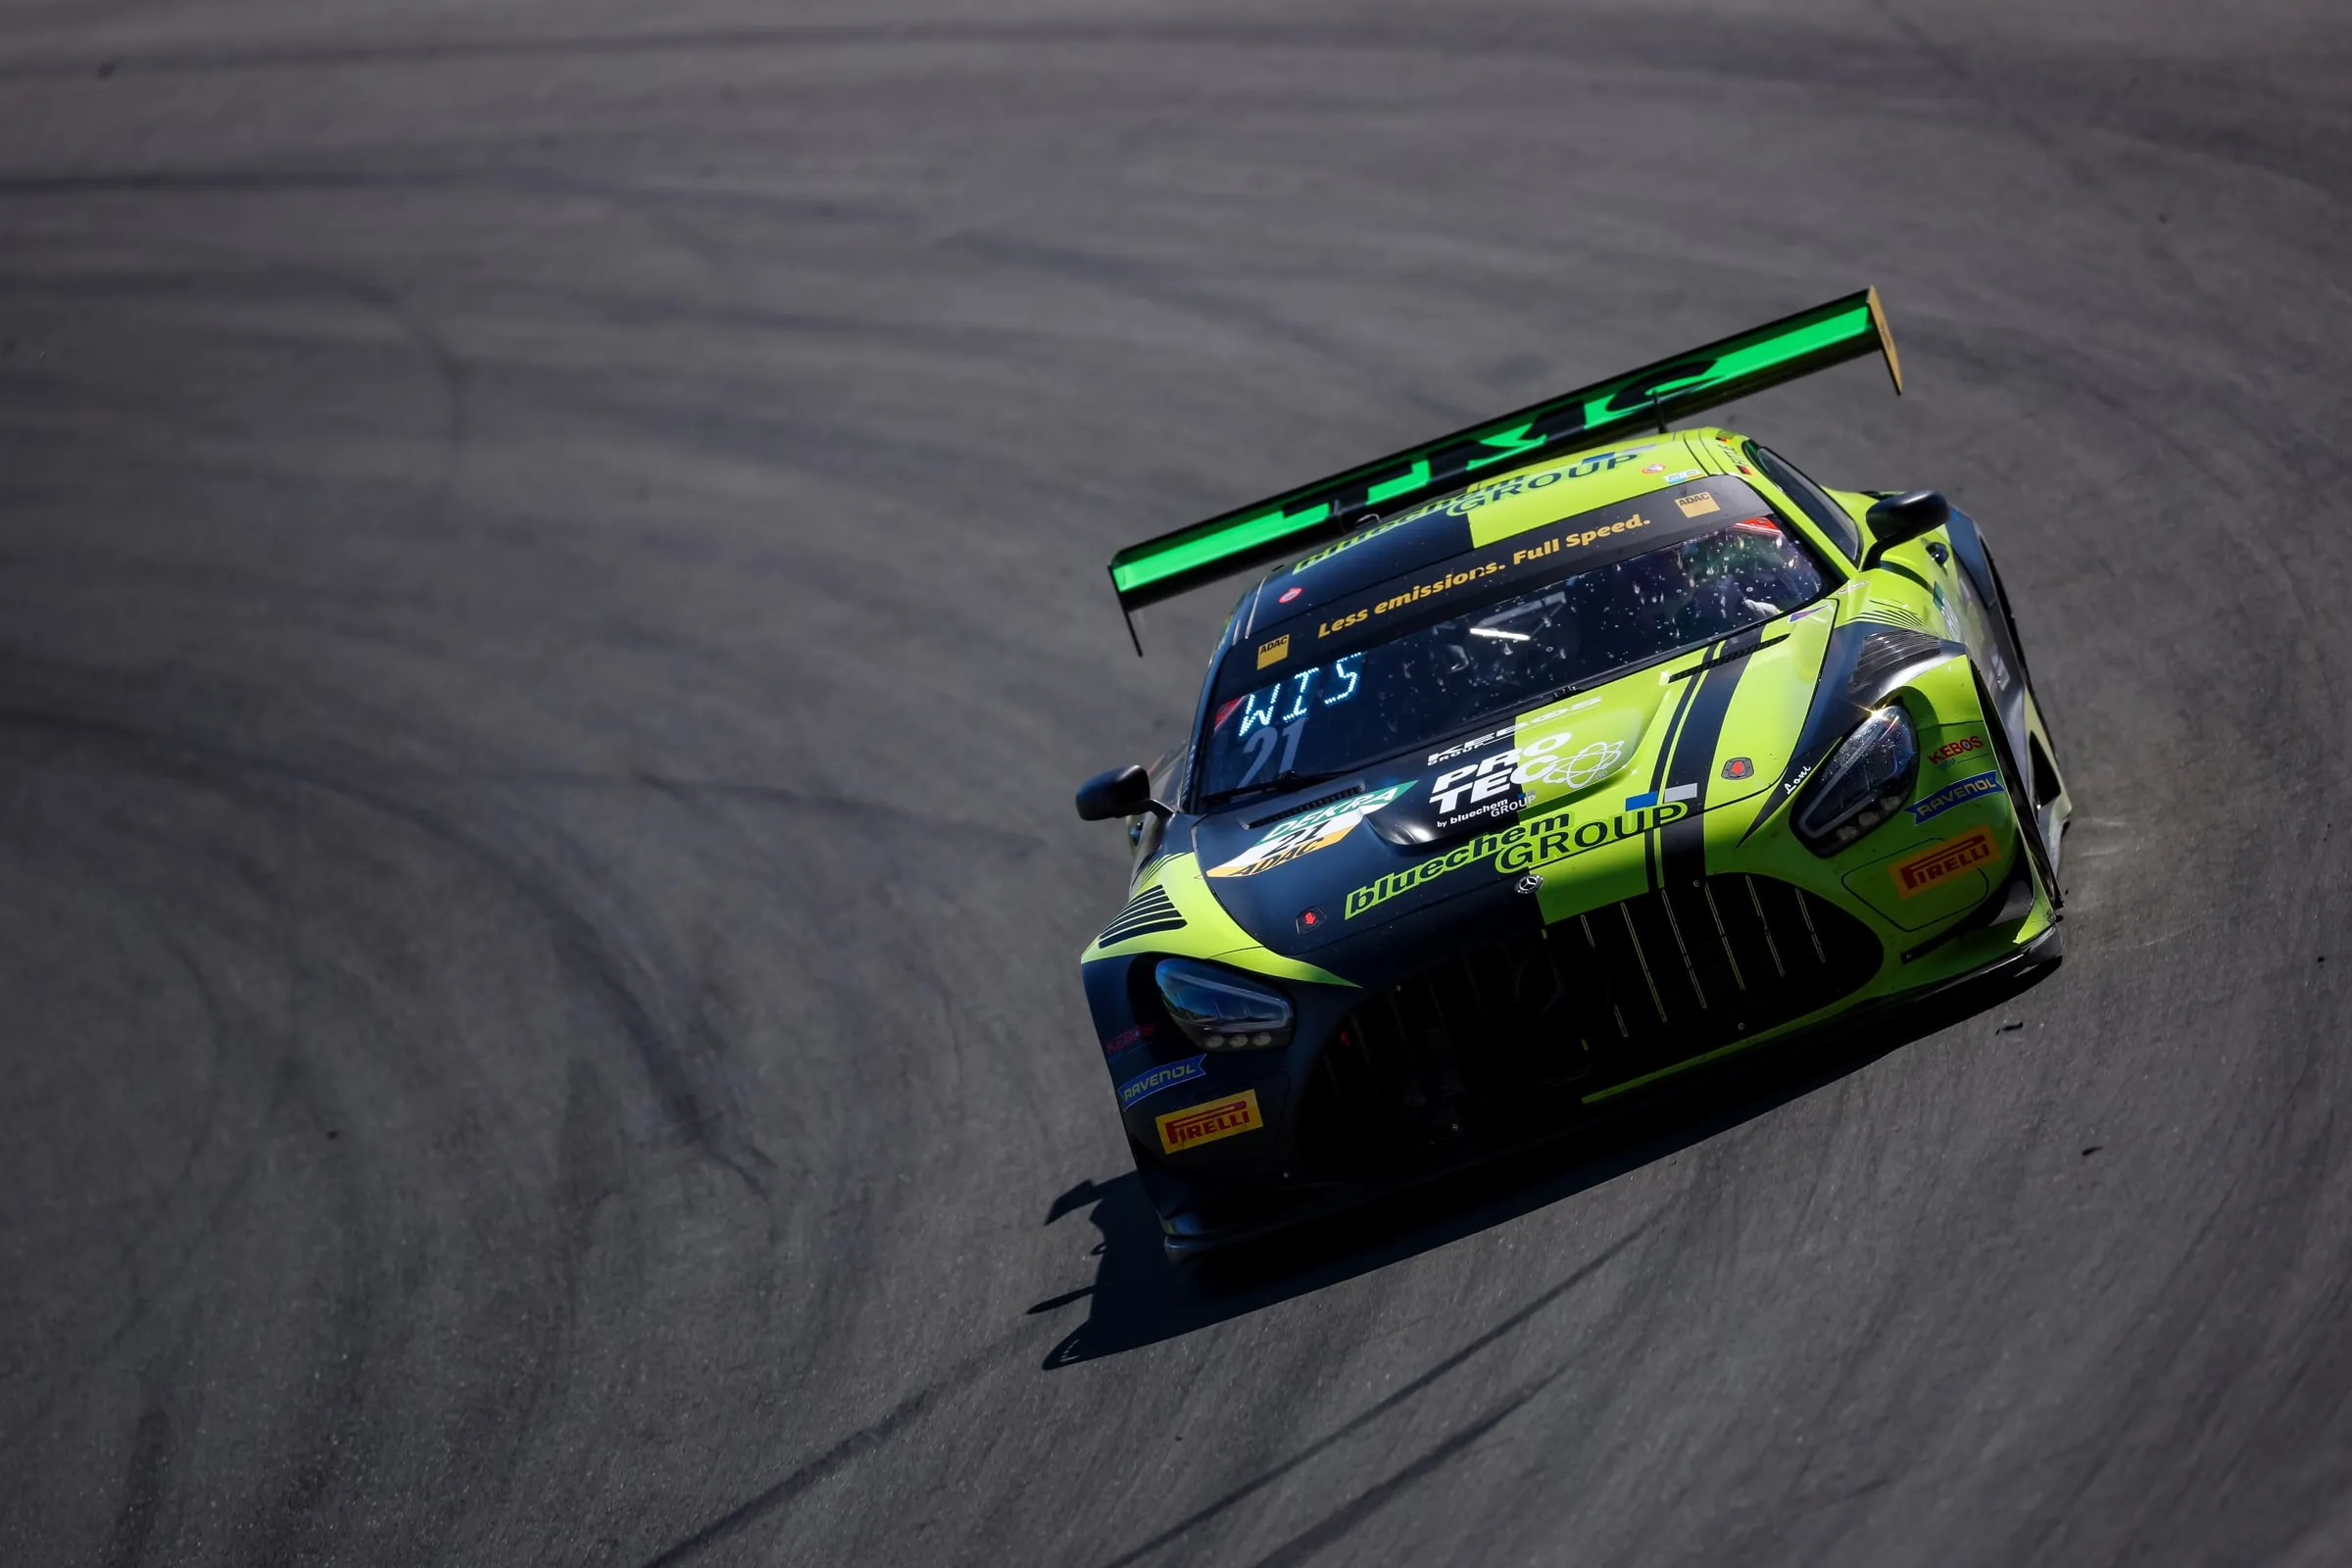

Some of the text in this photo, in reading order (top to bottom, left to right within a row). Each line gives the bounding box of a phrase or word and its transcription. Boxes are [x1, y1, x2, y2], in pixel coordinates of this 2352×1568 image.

[1447, 453, 1639, 518] GROUP
[1678, 493, 1710, 507] ADAC
[1317, 514, 1650, 638] Less emissions. Full Speed.
[1259, 636, 1288, 655] ADAC
[1237, 717, 1309, 789] 21
[1432, 732, 1572, 794] PRO
[1928, 735, 1984, 764] KEBOS
[1260, 788, 1398, 842] DEKRA
[1450, 799, 1508, 824] bluechem
[1491, 795, 1537, 817] GROUP
[1916, 779, 1996, 817] RAVENOL
[1229, 838, 1324, 876] ADAC
[1494, 802, 1688, 874] GROUP
[1345, 811, 1571, 920] bluechem
[1899, 834, 1989, 890] PIRELLI
[1123, 1063, 1196, 1102] RAVENOL
[1164, 1100, 1250, 1145] PIRELLI
